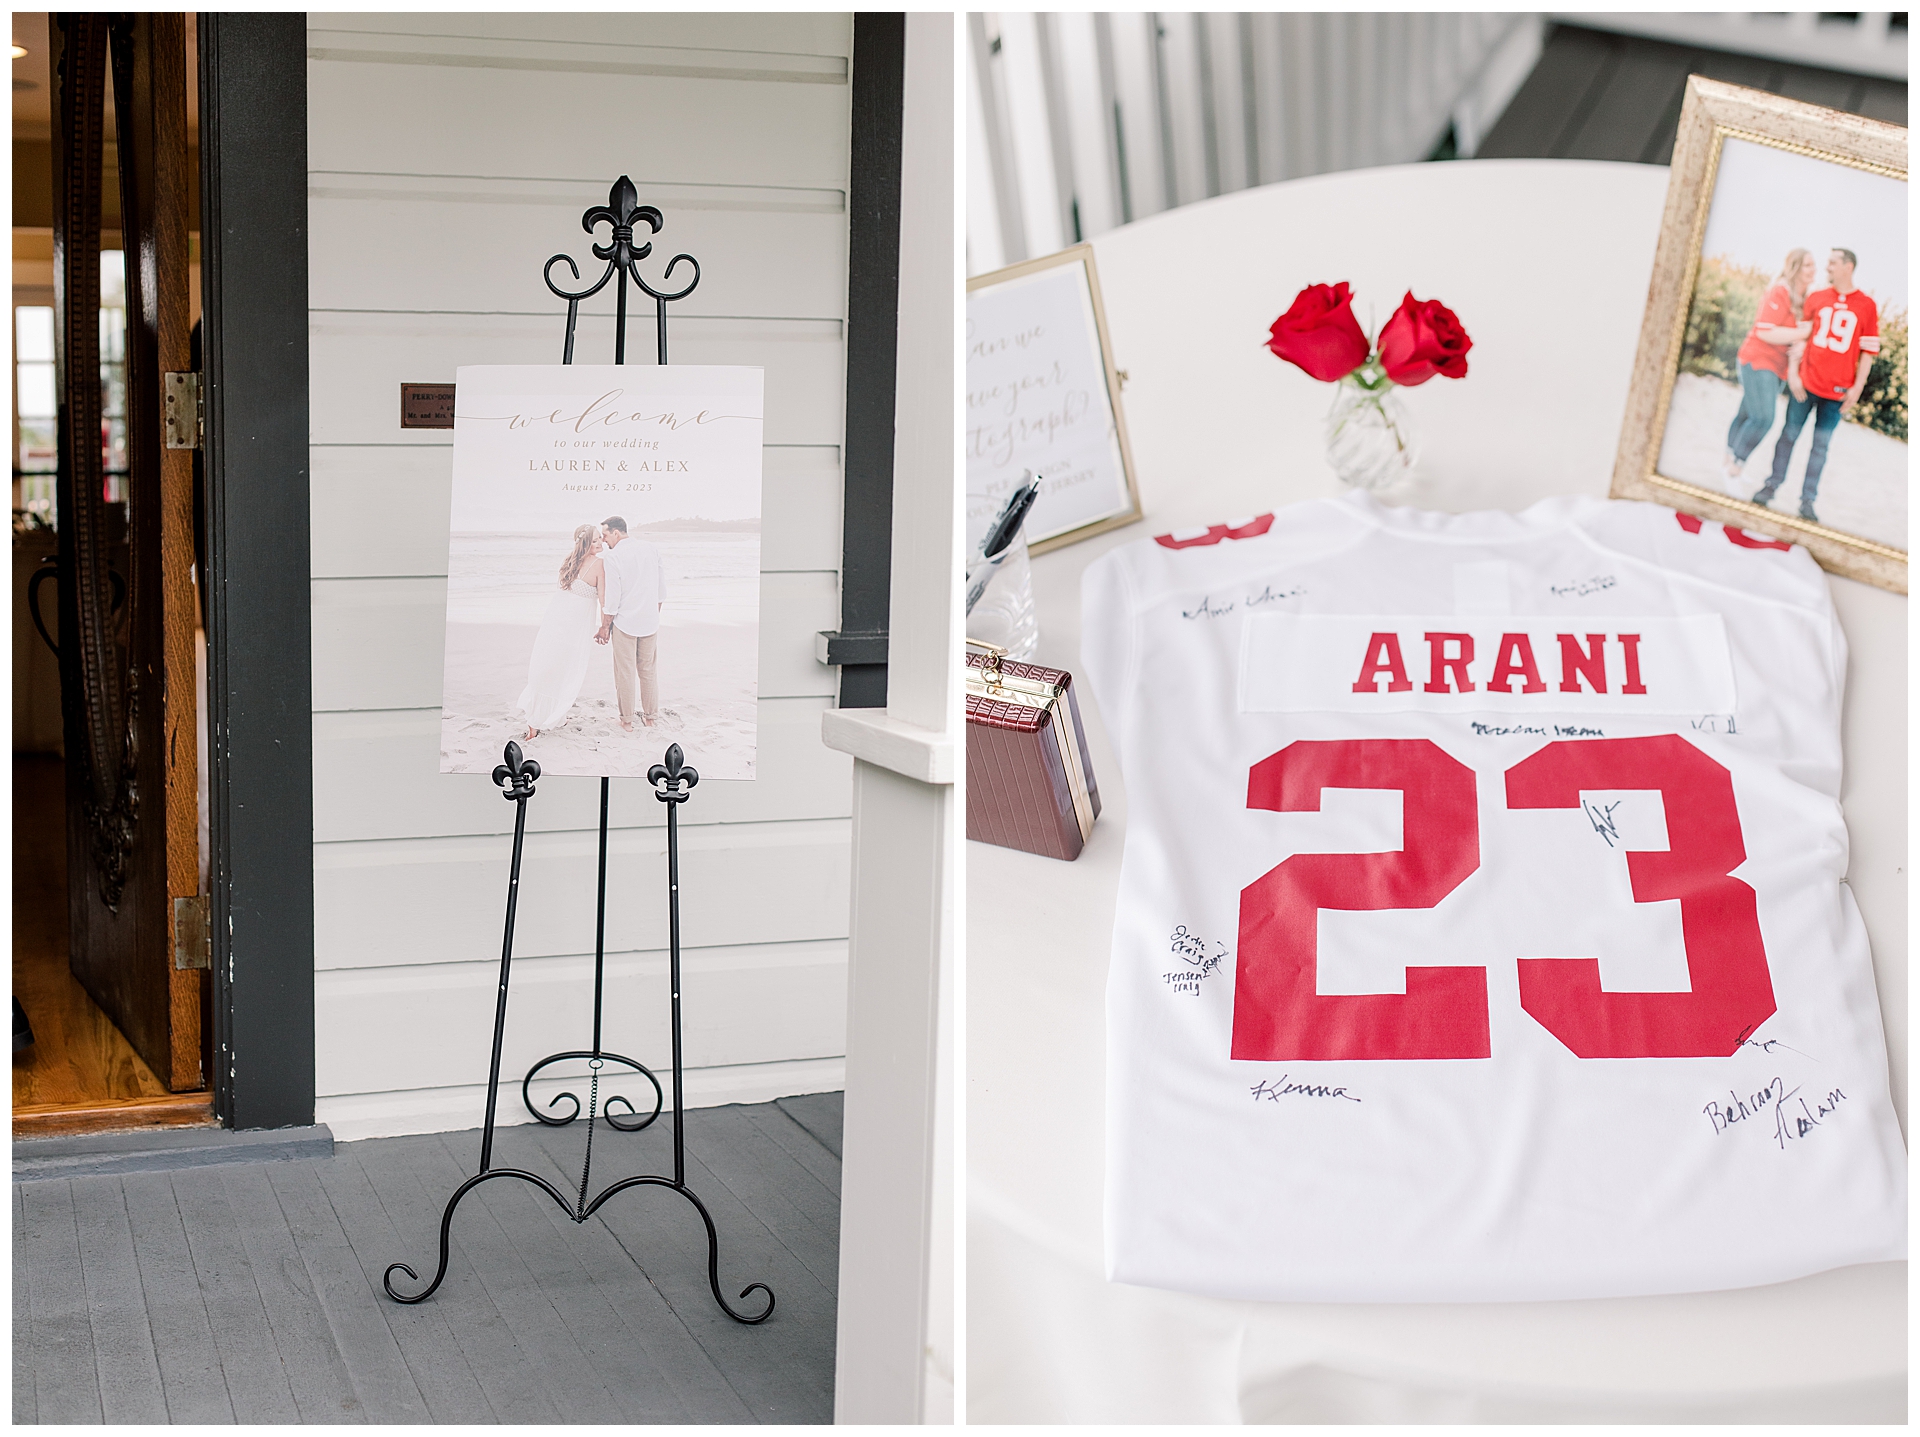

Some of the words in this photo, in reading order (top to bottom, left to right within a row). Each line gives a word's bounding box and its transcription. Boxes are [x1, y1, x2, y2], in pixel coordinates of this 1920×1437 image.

[1812, 306, 1858, 354] 19
[495, 388, 730, 434] welcome
[553, 437, 567, 449] to
[573, 439, 598, 449] our
[602, 437, 661, 451] wedding
[528, 458, 607, 473] LAUREN
[616, 459, 630, 473] &
[639, 459, 691, 473] ALEX
[561, 482, 599, 493] August
[603, 482, 621, 493] 25,
[626, 482, 653, 492] 2023
[1352, 632, 1647, 695] ARANI
[1230, 734, 1778, 1061] 23
[1162, 971, 1203, 984] Jensen
